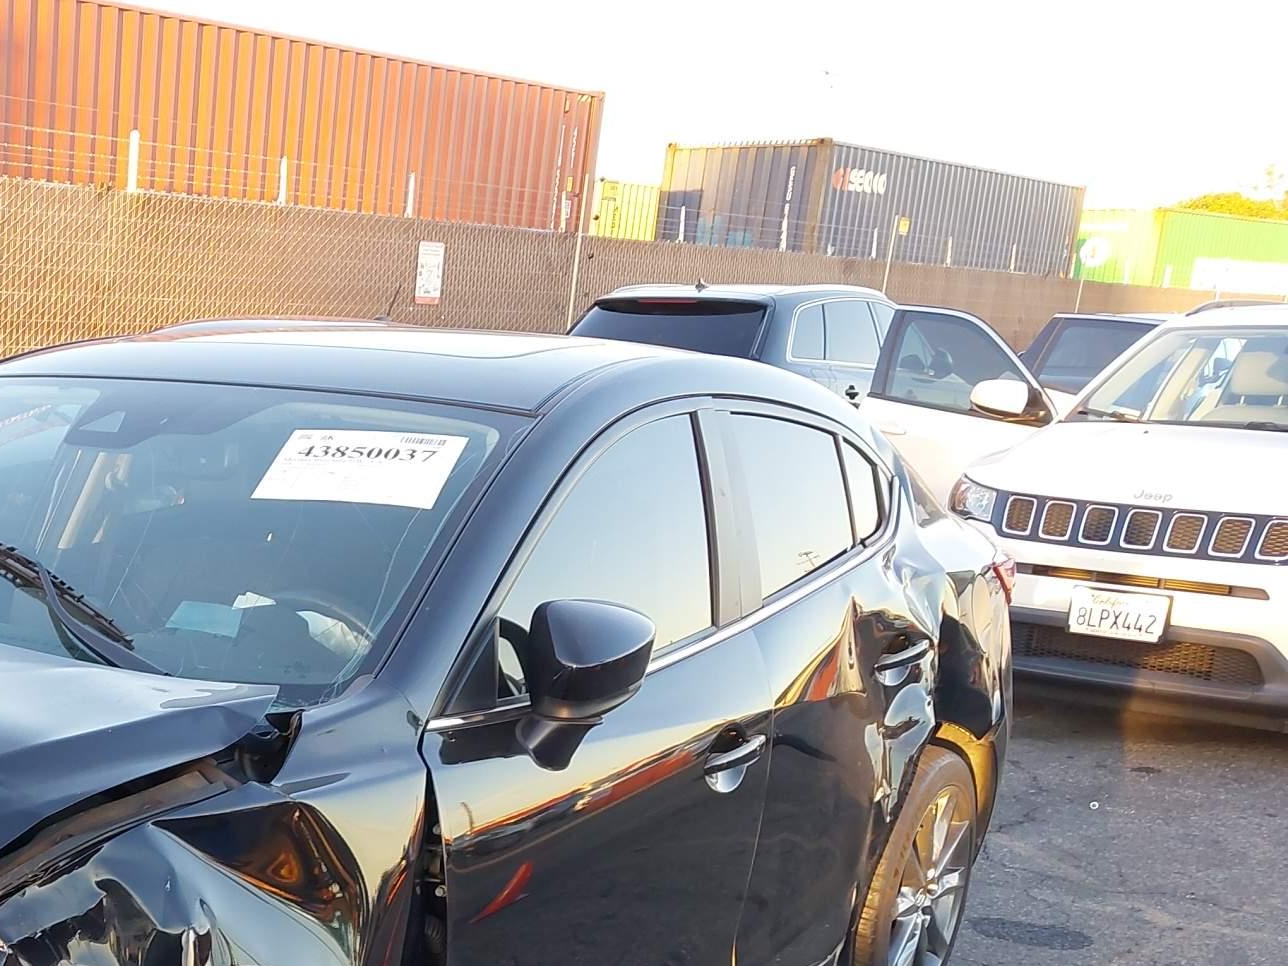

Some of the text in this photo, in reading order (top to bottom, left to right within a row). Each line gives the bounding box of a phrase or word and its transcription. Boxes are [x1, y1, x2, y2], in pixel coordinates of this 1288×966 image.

[297, 444, 439, 463] 43850037
[1133, 489, 1174, 504] Jeep
[1076, 606, 1158, 635] 8LPX442
